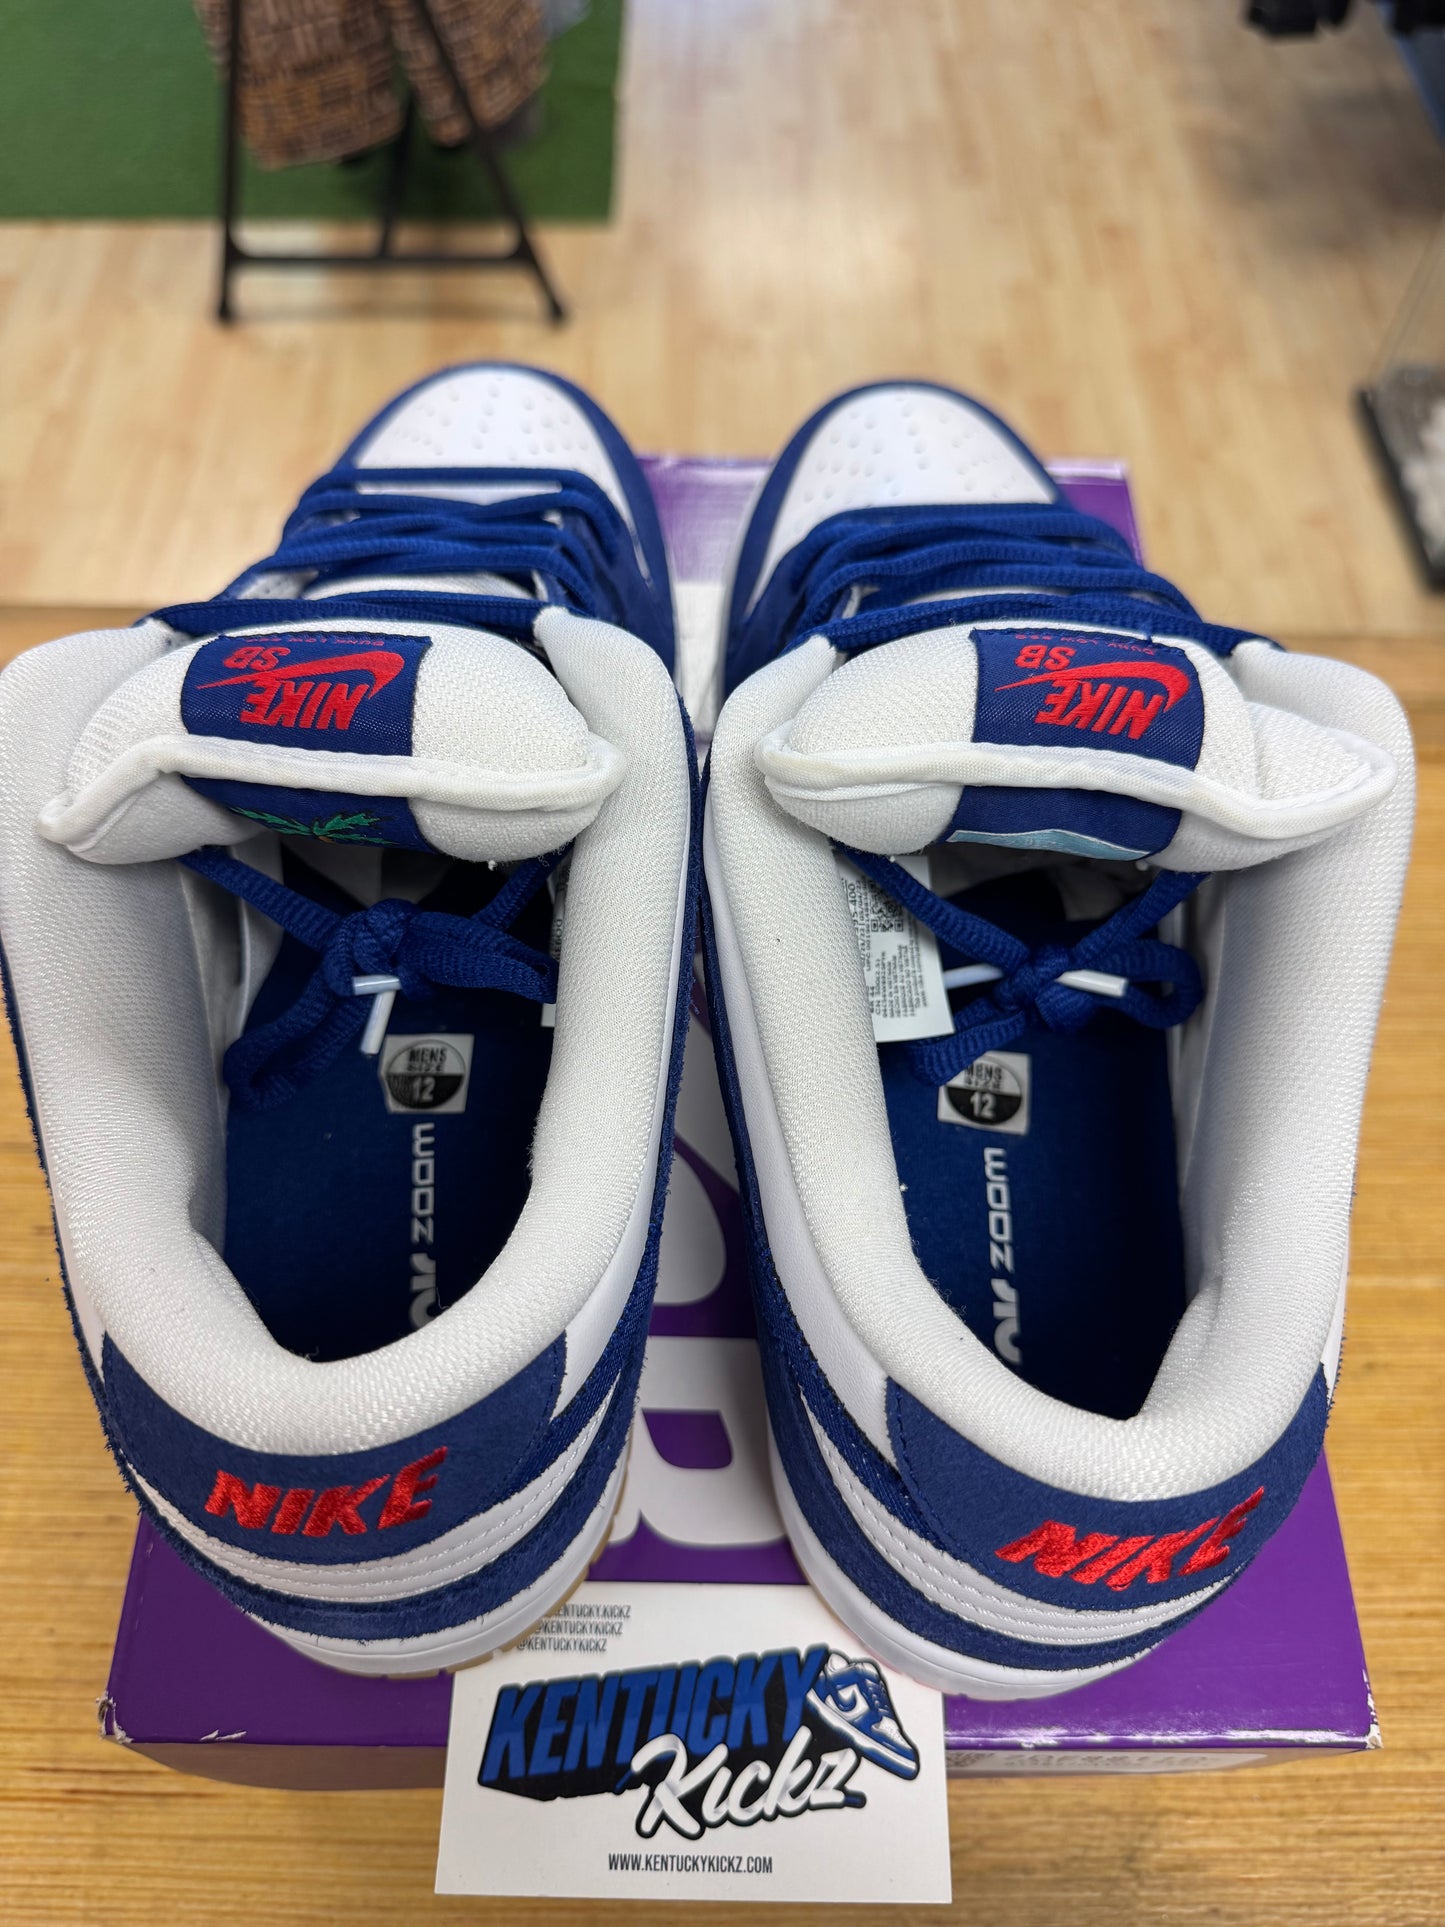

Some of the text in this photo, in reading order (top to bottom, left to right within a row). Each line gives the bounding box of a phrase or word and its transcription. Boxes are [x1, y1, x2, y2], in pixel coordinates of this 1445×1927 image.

[222, 646, 291, 671] SB
[1014, 645, 1076, 671] SB
[239, 679, 370, 730] NIKE
[1033, 679, 1166, 740] NIKE
[411, 1076, 436, 1103] 12
[969, 1091, 996, 1118] 12
[203, 1446, 448, 1537] NIKE
[994, 1486, 1265, 1591] NIKE
[479, 1643, 831, 1785] KENTUCKY
[631, 1725, 864, 1838] Kickz
[607, 1852, 774, 1875] WWW.KENTUCKYKICKZ.COM
